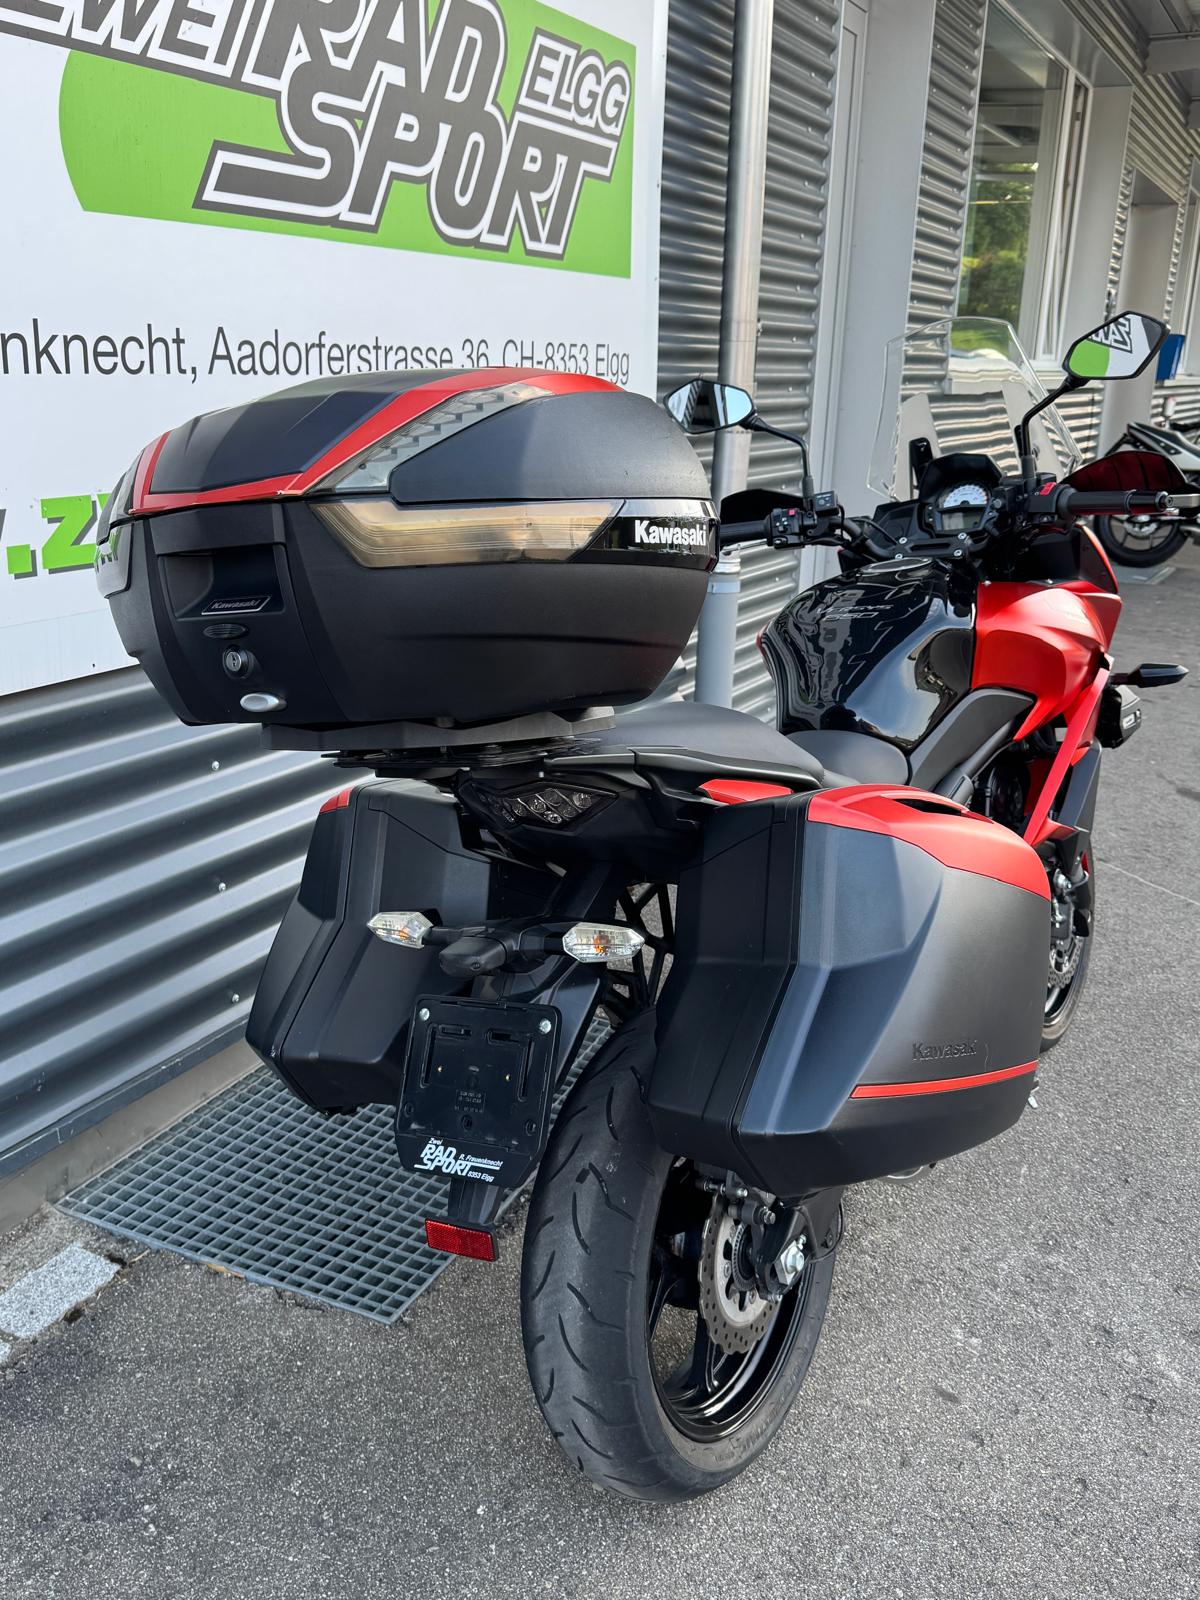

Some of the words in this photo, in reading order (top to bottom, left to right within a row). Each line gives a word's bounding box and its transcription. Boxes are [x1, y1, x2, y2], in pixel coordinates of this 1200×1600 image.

[520, 30, 630, 136] ELGG
[195, 56, 616, 258] SPORT
[207, 326, 454, 376] Aadorferstrasse
[502, 339, 589, 375] CH-8353
[595, 343, 630, 385] Elgg
[633, 519, 707, 547] Kawasaki
[210, 598, 262, 610] Kawasaki
[911, 1039, 977, 1061] Kawasaki
[420, 1143, 457, 1160] RAD
